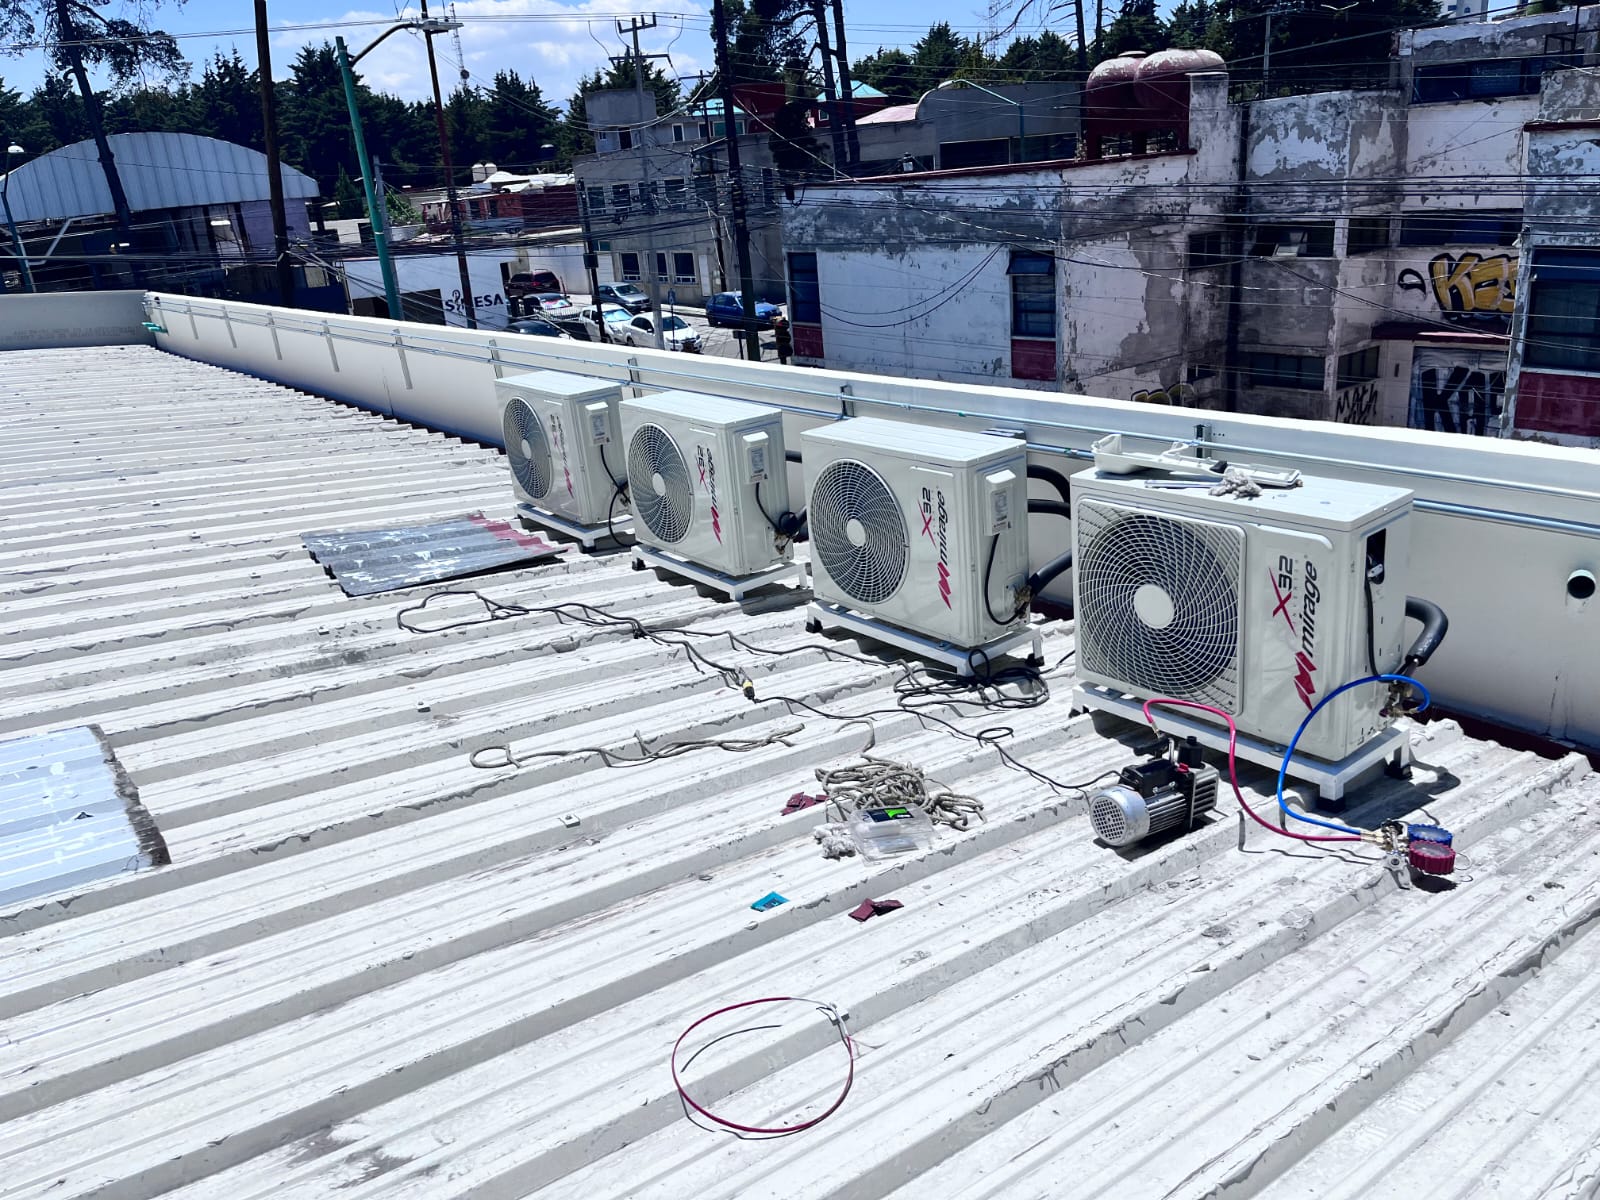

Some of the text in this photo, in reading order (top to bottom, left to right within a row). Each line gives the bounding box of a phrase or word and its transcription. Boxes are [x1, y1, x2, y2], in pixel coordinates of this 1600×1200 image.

[917, 487, 937, 549] X32
[937, 490, 948, 567] mirage
[1268, 555, 1297, 637] X32
[1299, 560, 1321, 658] mirage
